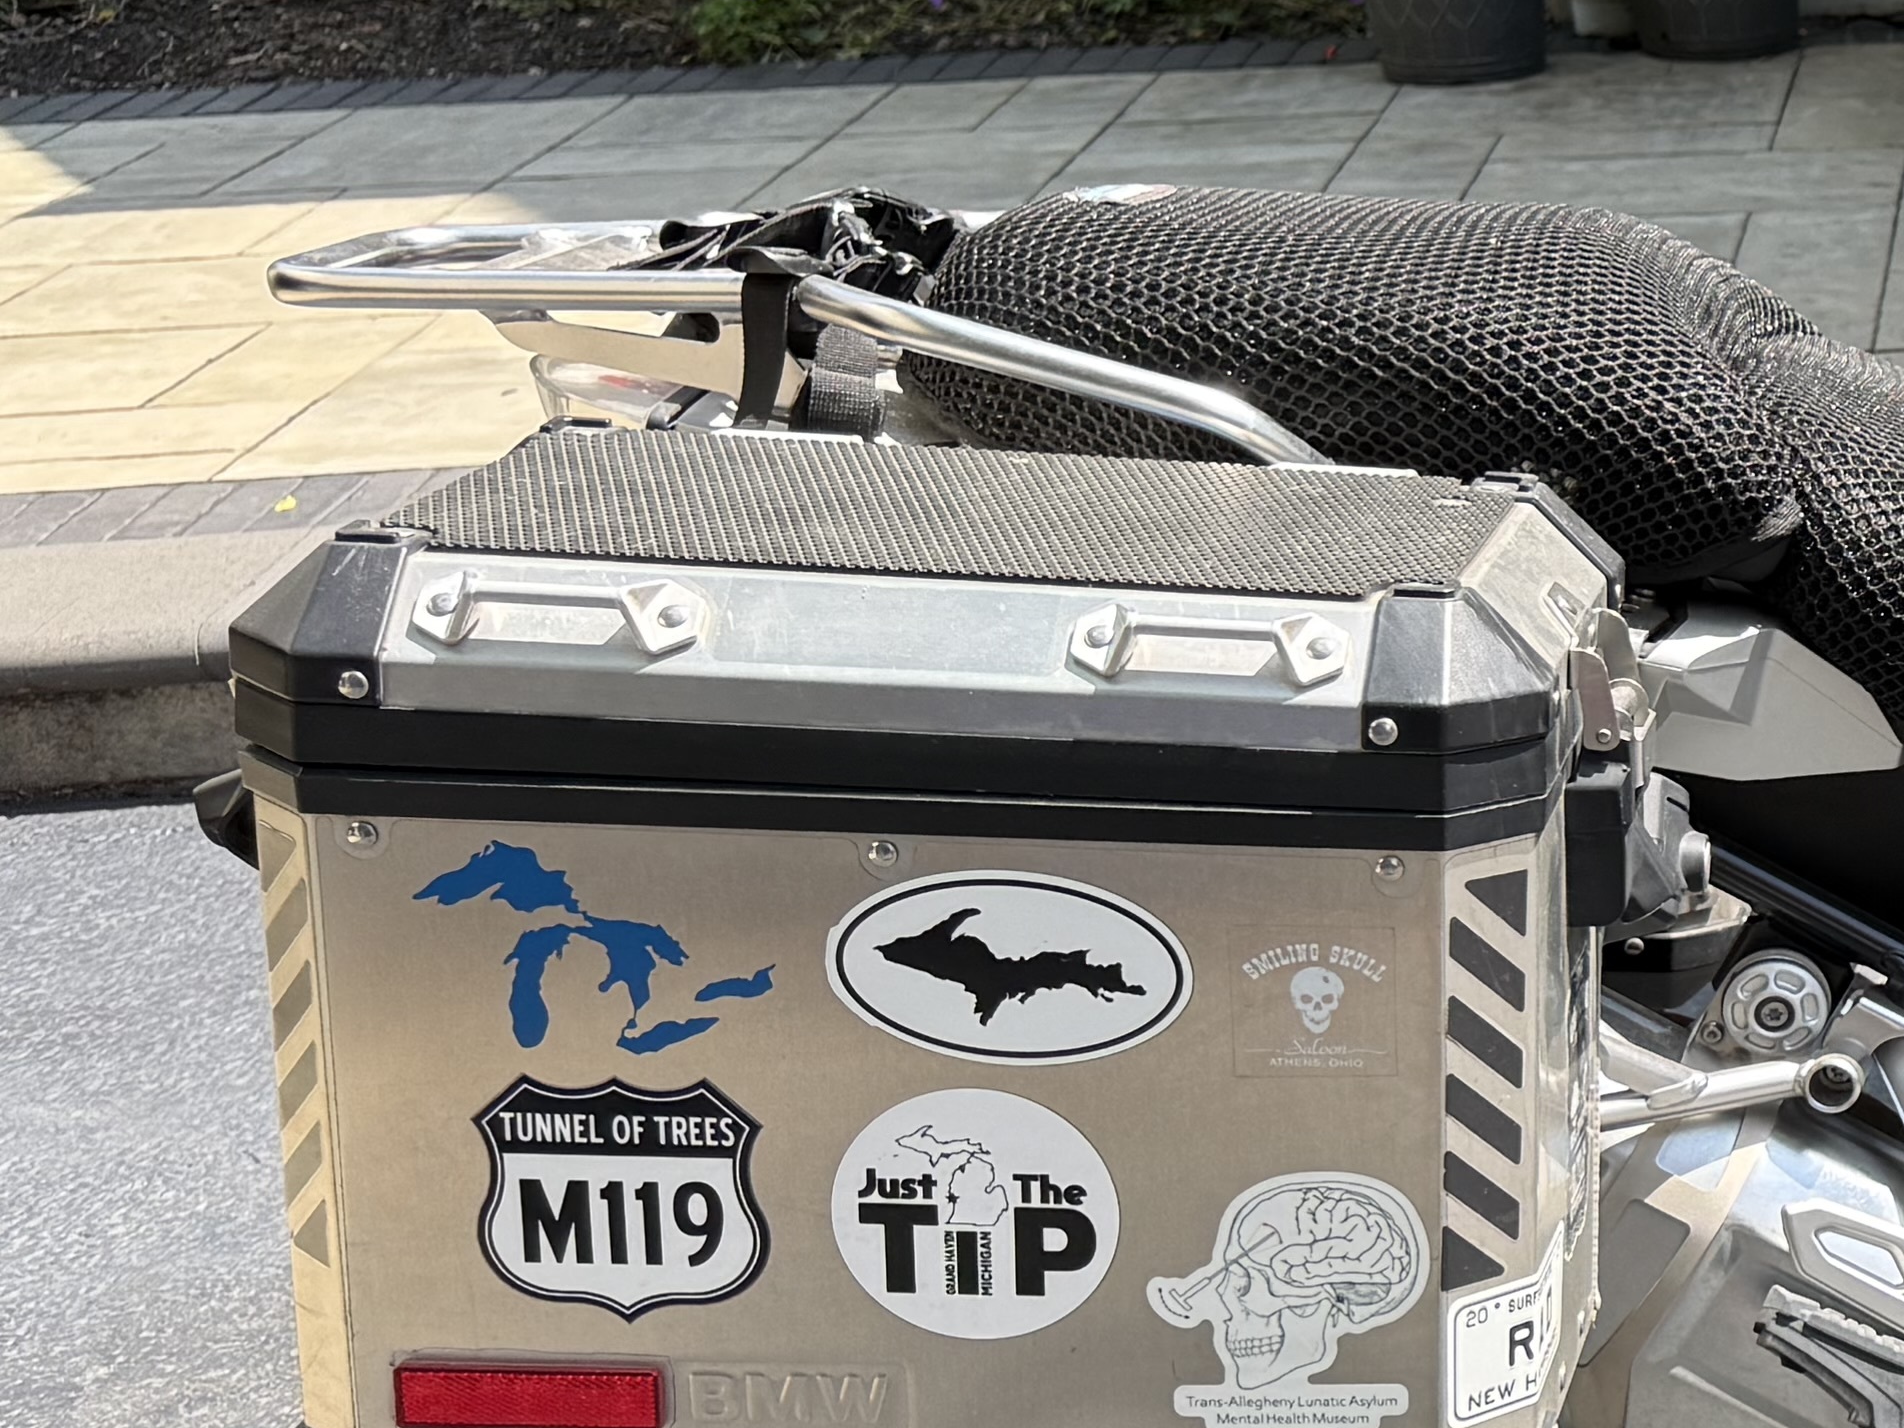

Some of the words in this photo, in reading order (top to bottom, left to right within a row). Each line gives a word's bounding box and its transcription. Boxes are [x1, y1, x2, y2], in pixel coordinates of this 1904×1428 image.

[1242, 943, 1319, 980] SMILING
[1329, 945, 1387, 983] SKULL
[1329, 1057, 1364, 1068] OHIO
[499, 1112, 604, 1144] TUNNEL
[611, 1114, 646, 1145] OF
[653, 1115, 735, 1147] TREES
[858, 1168, 938, 1199] Just
[1013, 1174, 1087, 1205] The
[519, 1178, 724, 1267] M119
[979, 1231, 992, 1296] MICHIGAN
[689, 1370, 889, 1424] BMW
[1186, 1395, 1295, 1410] Trans-Allegheny
[1298, 1395, 1346, 1407] Lunatic
[1349, 1395, 1398, 1410] Asylum
[1468, 1378, 1516, 1411] NEW
[1217, 1413, 1264, 1424] Mental
[1267, 1413, 1310, 1424] Health
[1313, 1413, 1369, 1424] Museum
